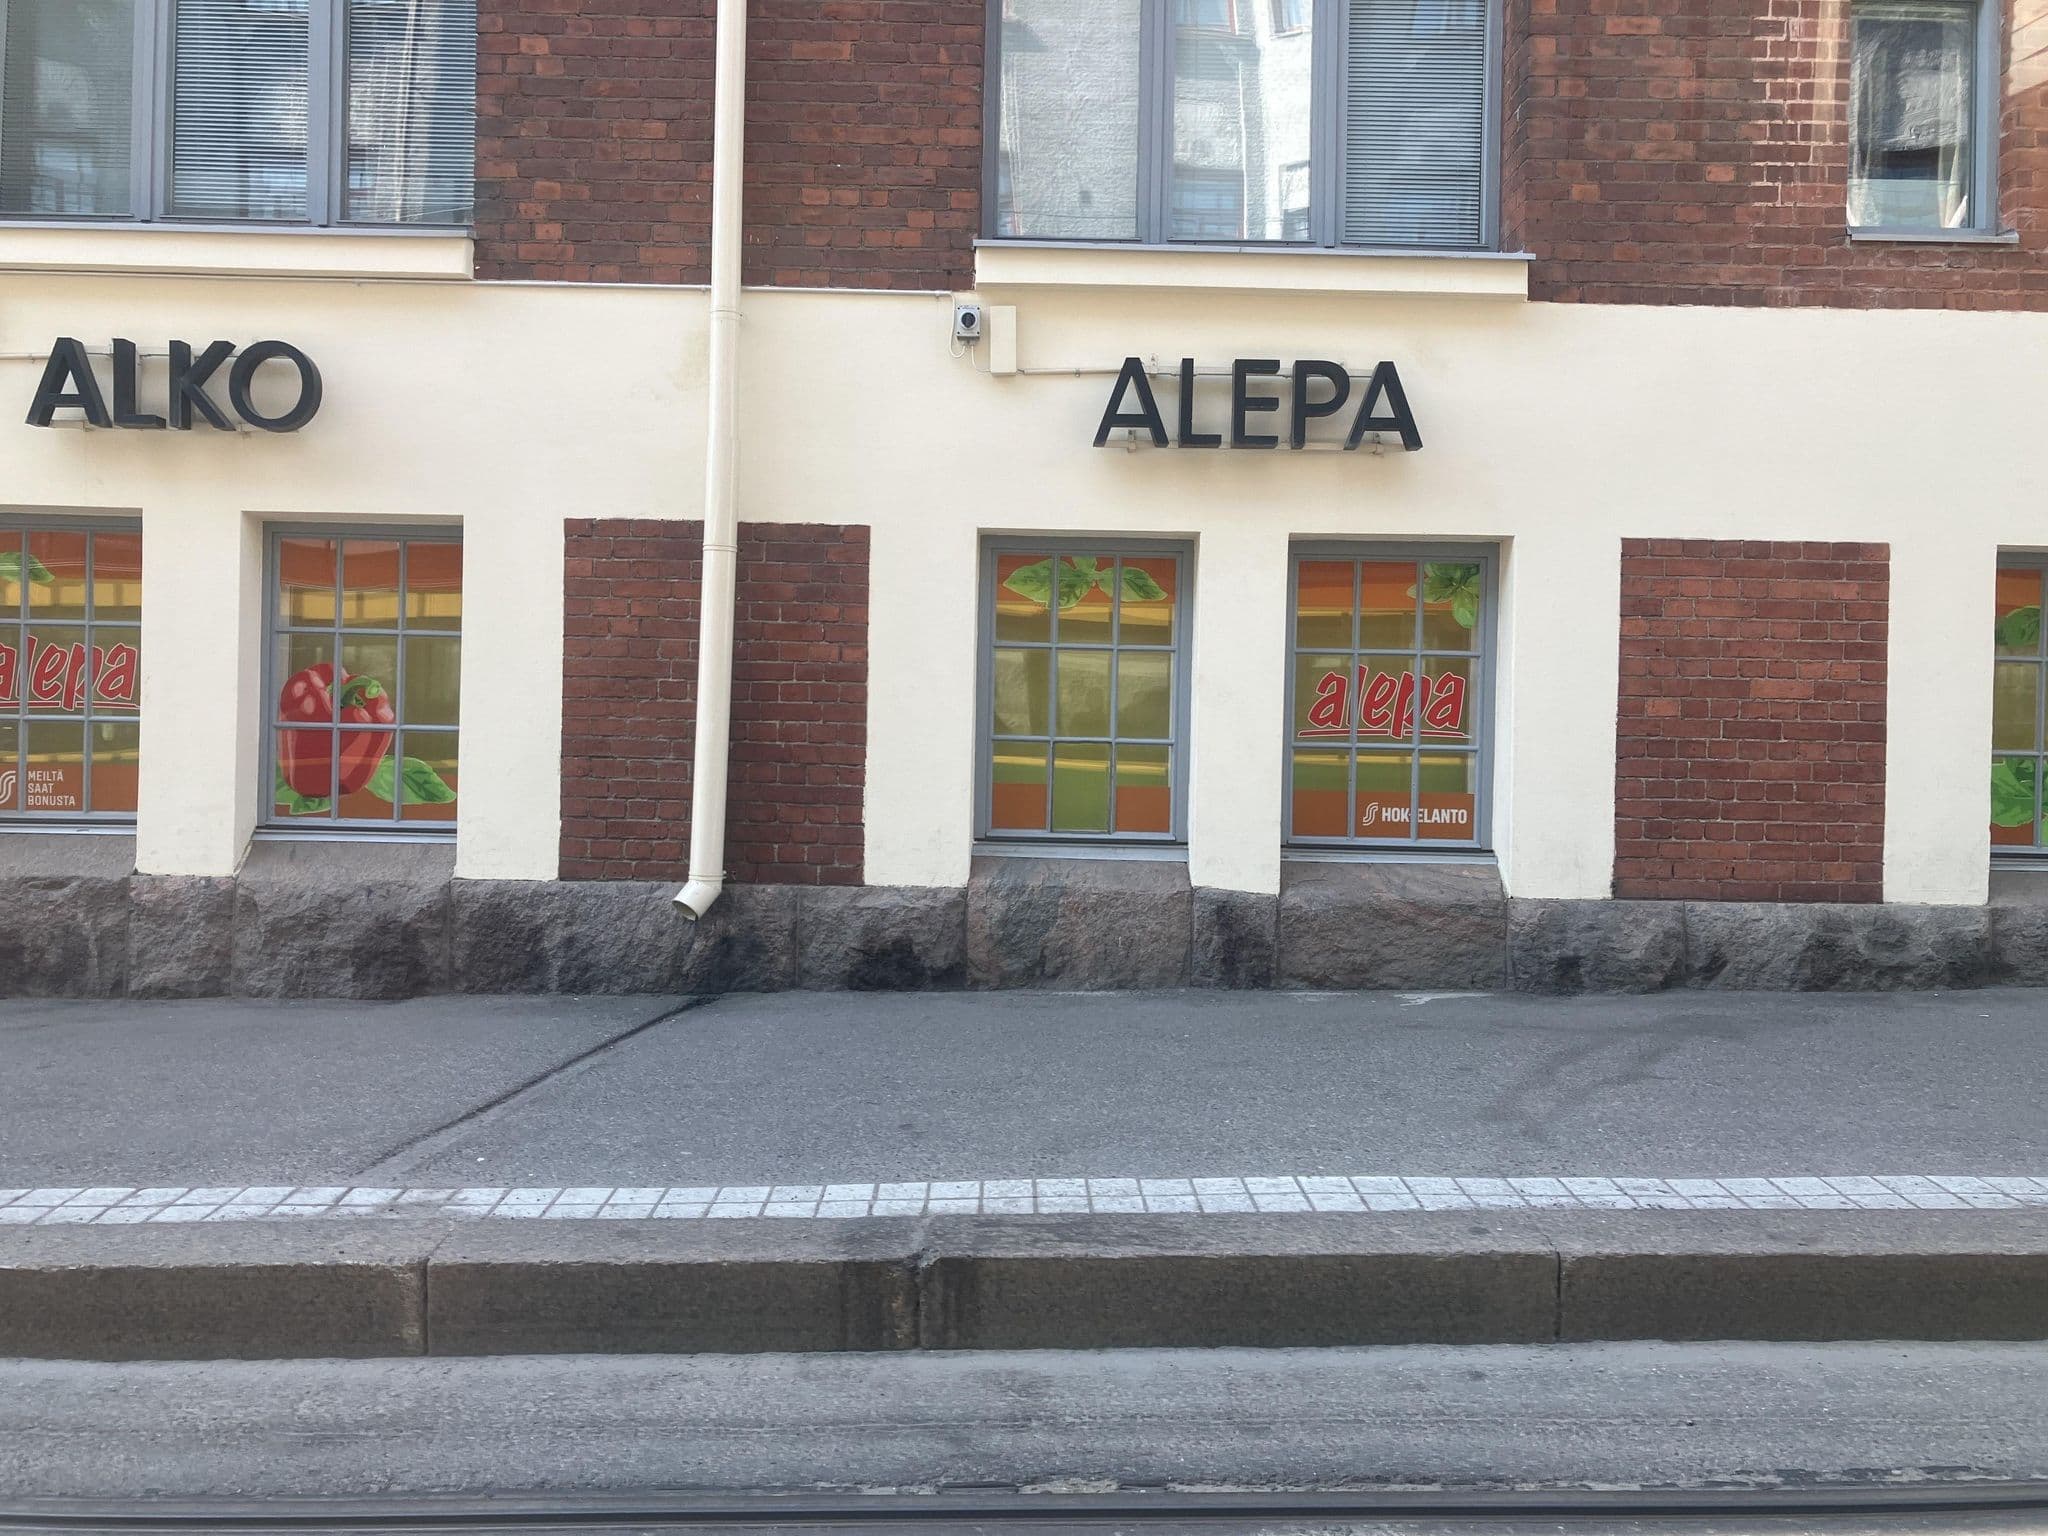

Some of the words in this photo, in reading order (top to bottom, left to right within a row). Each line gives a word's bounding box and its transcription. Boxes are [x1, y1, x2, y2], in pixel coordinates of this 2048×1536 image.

[25, 337, 323, 433] ALKO
[1093, 357, 1423, 451] ALEPA
[1308, 664, 1466, 739] alepa
[27, 769, 64, 781] MEILTÄ
[27, 783, 54, 794] SAAT
[27, 795, 76, 806] BONUSTA
